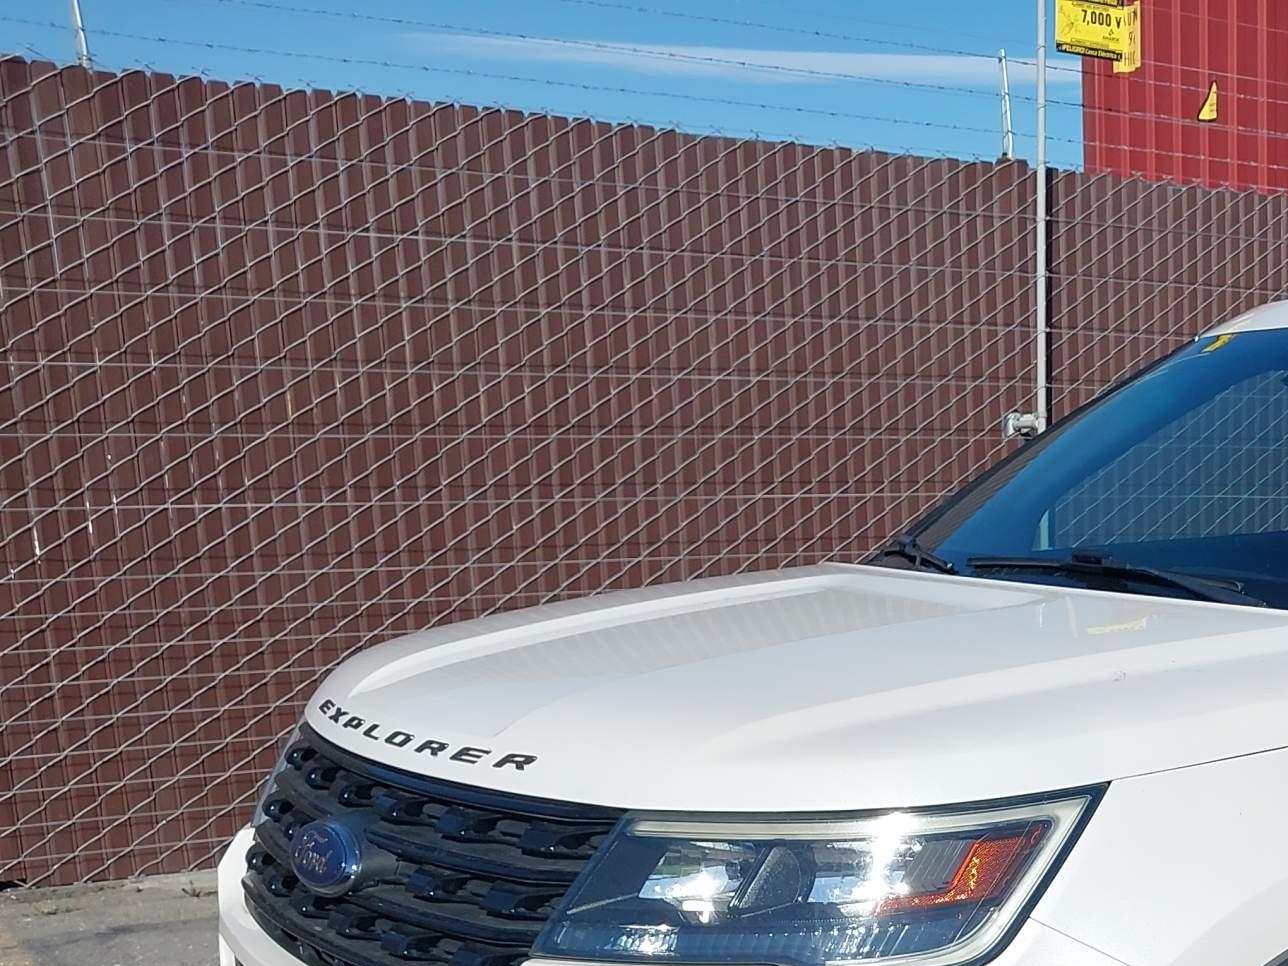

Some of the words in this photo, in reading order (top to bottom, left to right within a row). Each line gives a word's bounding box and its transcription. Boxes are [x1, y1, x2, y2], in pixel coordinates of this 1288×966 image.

[1081, 9, 1112, 27] 7,000
[1115, 16, 1122, 29] V
[318, 698, 538, 772] EXPLORER
